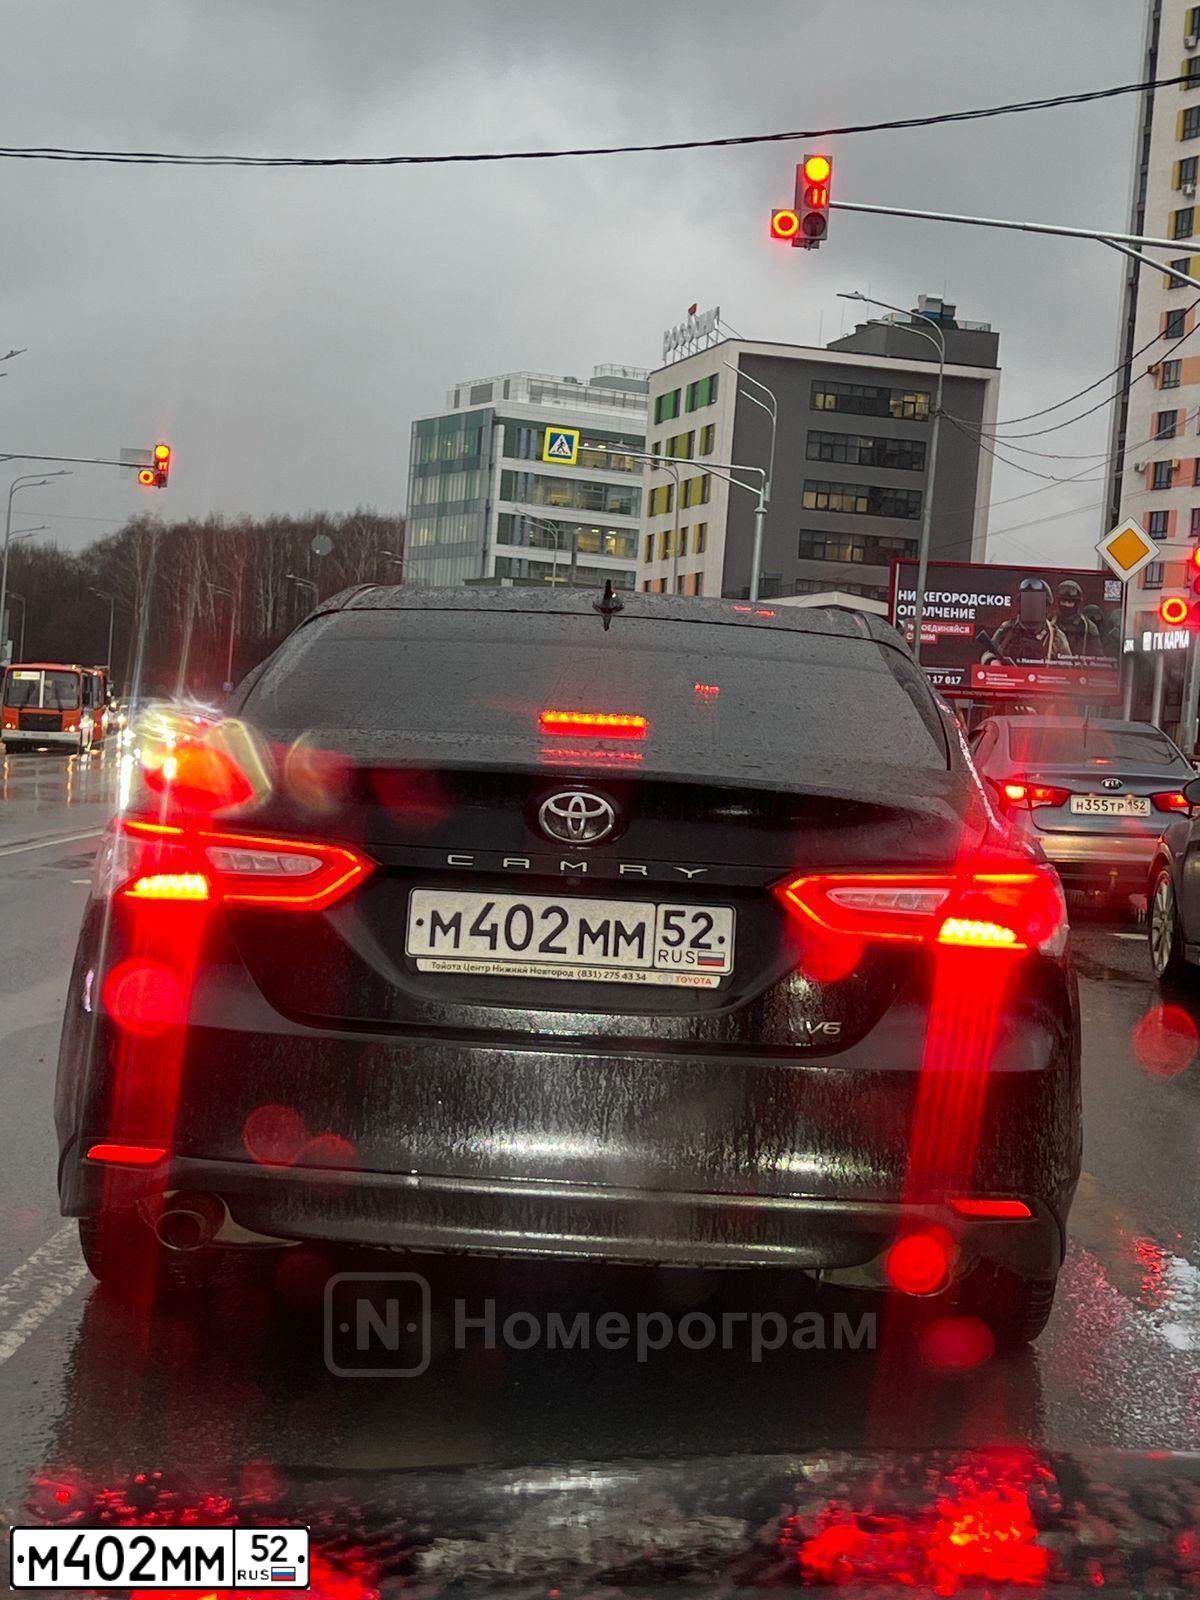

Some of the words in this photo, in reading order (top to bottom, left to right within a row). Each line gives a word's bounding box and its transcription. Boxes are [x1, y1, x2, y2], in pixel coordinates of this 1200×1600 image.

[1076, 798, 1125, 812] Н355ТР
[447, 854, 708, 879] CAMRY
[429, 902, 646, 959] М402ММ
[661, 910, 715, 950] 52
[658, 949, 695, 964] RUS
[431, 961, 461, 970] Тойота
[463, 962, 491, 973] Центр
[492, 964, 528, 974] Нижний
[529, 966, 575, 978] Новгород
[577, 968, 602, 979] (831)
[603, 970, 620, 980] 275
[621, 972, 634, 981] 43
[635, 972, 647, 982] 34
[675, 974, 712, 986] TOYOTA
[805, 1020, 842, 1035] V6
